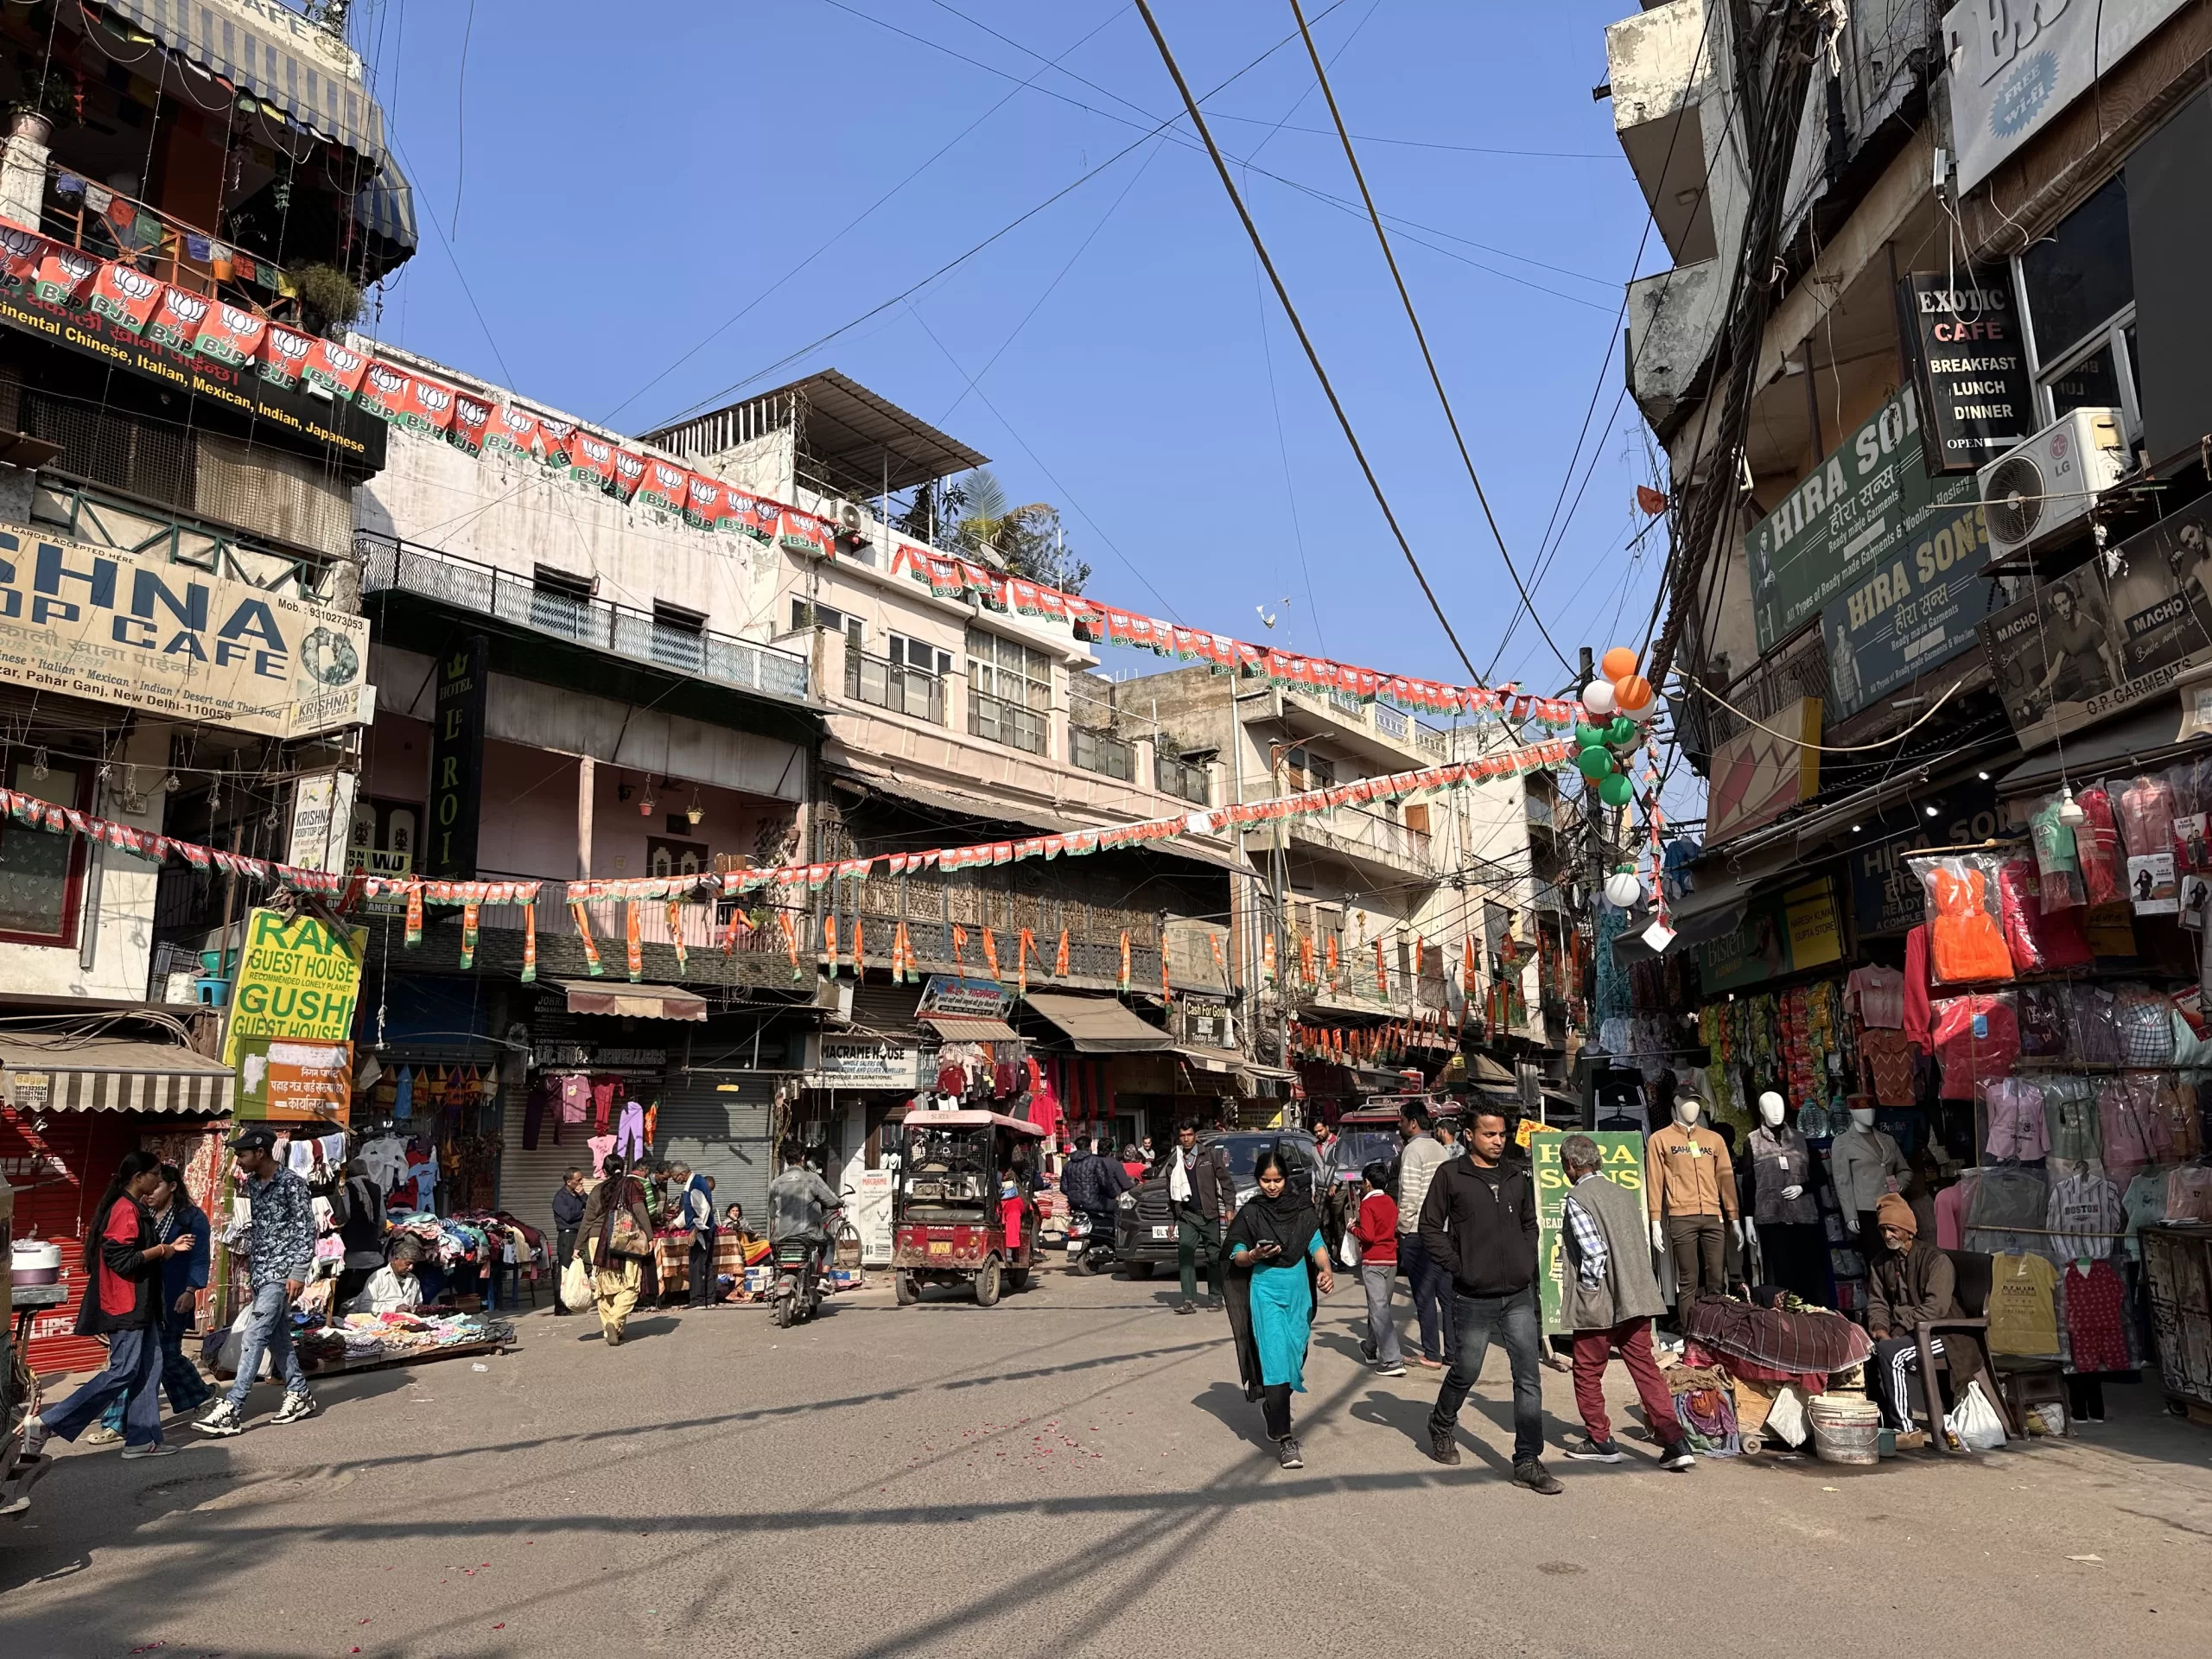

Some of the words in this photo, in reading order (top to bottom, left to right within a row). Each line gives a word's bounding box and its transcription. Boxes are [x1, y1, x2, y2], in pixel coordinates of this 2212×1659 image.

[2003, 64, 2041, 104] FREE
[41, 283, 85, 311] BJP
[1917, 289, 2005, 313] EXOTIC
[94, 296, 140, 327] BJP
[149, 324, 194, 352] BJP
[202, 337, 246, 363] BJP
[256, 360, 297, 388] BJP
[1930, 357, 2017, 373] BREAKFAST
[0, 301, 60, 335] inental
[65, 327, 132, 365] Chinese,
[137, 354, 188, 386] Italian,
[193, 377, 255, 413] Mexican,
[258, 401, 302, 432] Indian,
[306, 422, 365, 453] Japanese
[309, 369, 352, 395] BJP
[1953, 380, 2005, 397] LUNCH
[357, 394, 397, 419] BJP
[1954, 404, 2014, 420] DINNER
[406, 412, 444, 435] BJP
[446, 430, 479, 454] BJP
[487, 435, 524, 454] BJP
[1947, 438, 1983, 448] OPEN
[576, 468, 609, 488] BJP
[2055, 461, 2070, 477] LG
[645, 493, 679, 512] BJP
[1771, 458, 1847, 553] HIRA
[683, 507, 714, 529] BJP
[723, 518, 756, 535] BJP
[1827, 534, 1847, 554] Ready
[1848, 518, 1866, 542] made
[1866, 489, 1899, 527] Garments
[789, 536, 820, 550] BJP
[1786, 605, 1796, 624] All
[1796, 595, 1814, 619] Types
[1821, 574, 1840, 601] Ready
[1841, 560, 1860, 586] made
[1860, 536, 1894, 577] Garments
[1903, 502, 1936, 535] Woollen
[1936, 474, 1971, 512] Hosiery
[1847, 560, 1909, 632] HIRA
[1915, 504, 1988, 584] SONS
[0, 531, 289, 653] HNA
[936, 588, 961, 596] BJP
[278, 598, 302, 613] Mob.
[309, 607, 363, 630] 9310273053
[2133, 598, 2183, 633] MACHO
[0, 624, 60, 647] काली
[1891, 631, 1909, 652] Ready
[1909, 620, 1928, 643] made
[1929, 603, 1959, 635] Garments
[1996, 612, 2037, 642] MACHO
[112, 615, 288, 681] CAFE
[1923, 642, 1948, 664] Garments
[1216, 664, 1234, 673] BJP
[1246, 669, 1266, 677] BJP
[26, 670, 68, 687] Pahar
[73, 680, 108, 697] Ganj,
[113, 689, 143, 702] New
[147, 694, 232, 721] Delhi-110055
[38, 658, 76, 676] Italian
[86, 669, 130, 687] Mexican
[139, 680, 173, 696] Indian
[182, 690, 213, 705] Desert
[216, 699, 233, 709] and
[237, 702, 257, 714] Thai
[260, 708, 281, 720] Food
[439, 678, 473, 701] HOTEL
[2087, 697, 2112, 715] O.P.
[2114, 658, 2192, 704] GARMENTS
[297, 710, 330, 723] ROOFTOP
[331, 706, 349, 716] CAFE
[299, 693, 349, 716] KRISHNA
[295, 828, 317, 838] ROOFTOP
[1863, 832, 1932, 879] HIRA
[1883, 895, 1923, 917] READY
[1790, 912, 1814, 929] NARESH
[1795, 928, 1815, 942] GUPTA
[1815, 921, 1836, 936] STORE
[1707, 925, 1746, 968] Bisleri
[251, 948, 303, 976] GUEST
[305, 955, 355, 983] HOUSE
[249, 971, 301, 986] RECOMMENDED
[302, 979, 326, 989] LONELY
[327, 982, 351, 993] PLANET
[1187, 1002, 1201, 1015] Cash
[1202, 1004, 1211, 1016] For
[1213, 1005, 1225, 1018] Gold
[233, 1016, 287, 1037] GUEST
[289, 1021, 341, 1039] HOUSE
[1192, 1033, 1206, 1045] Today
[594, 1049, 666, 1065] JEWELLERS
[821, 1046, 870, 1058] MACRAME
[1538, 1143, 1638, 1165] HRA
[2064, 1205, 2098, 1215] BOSTON
